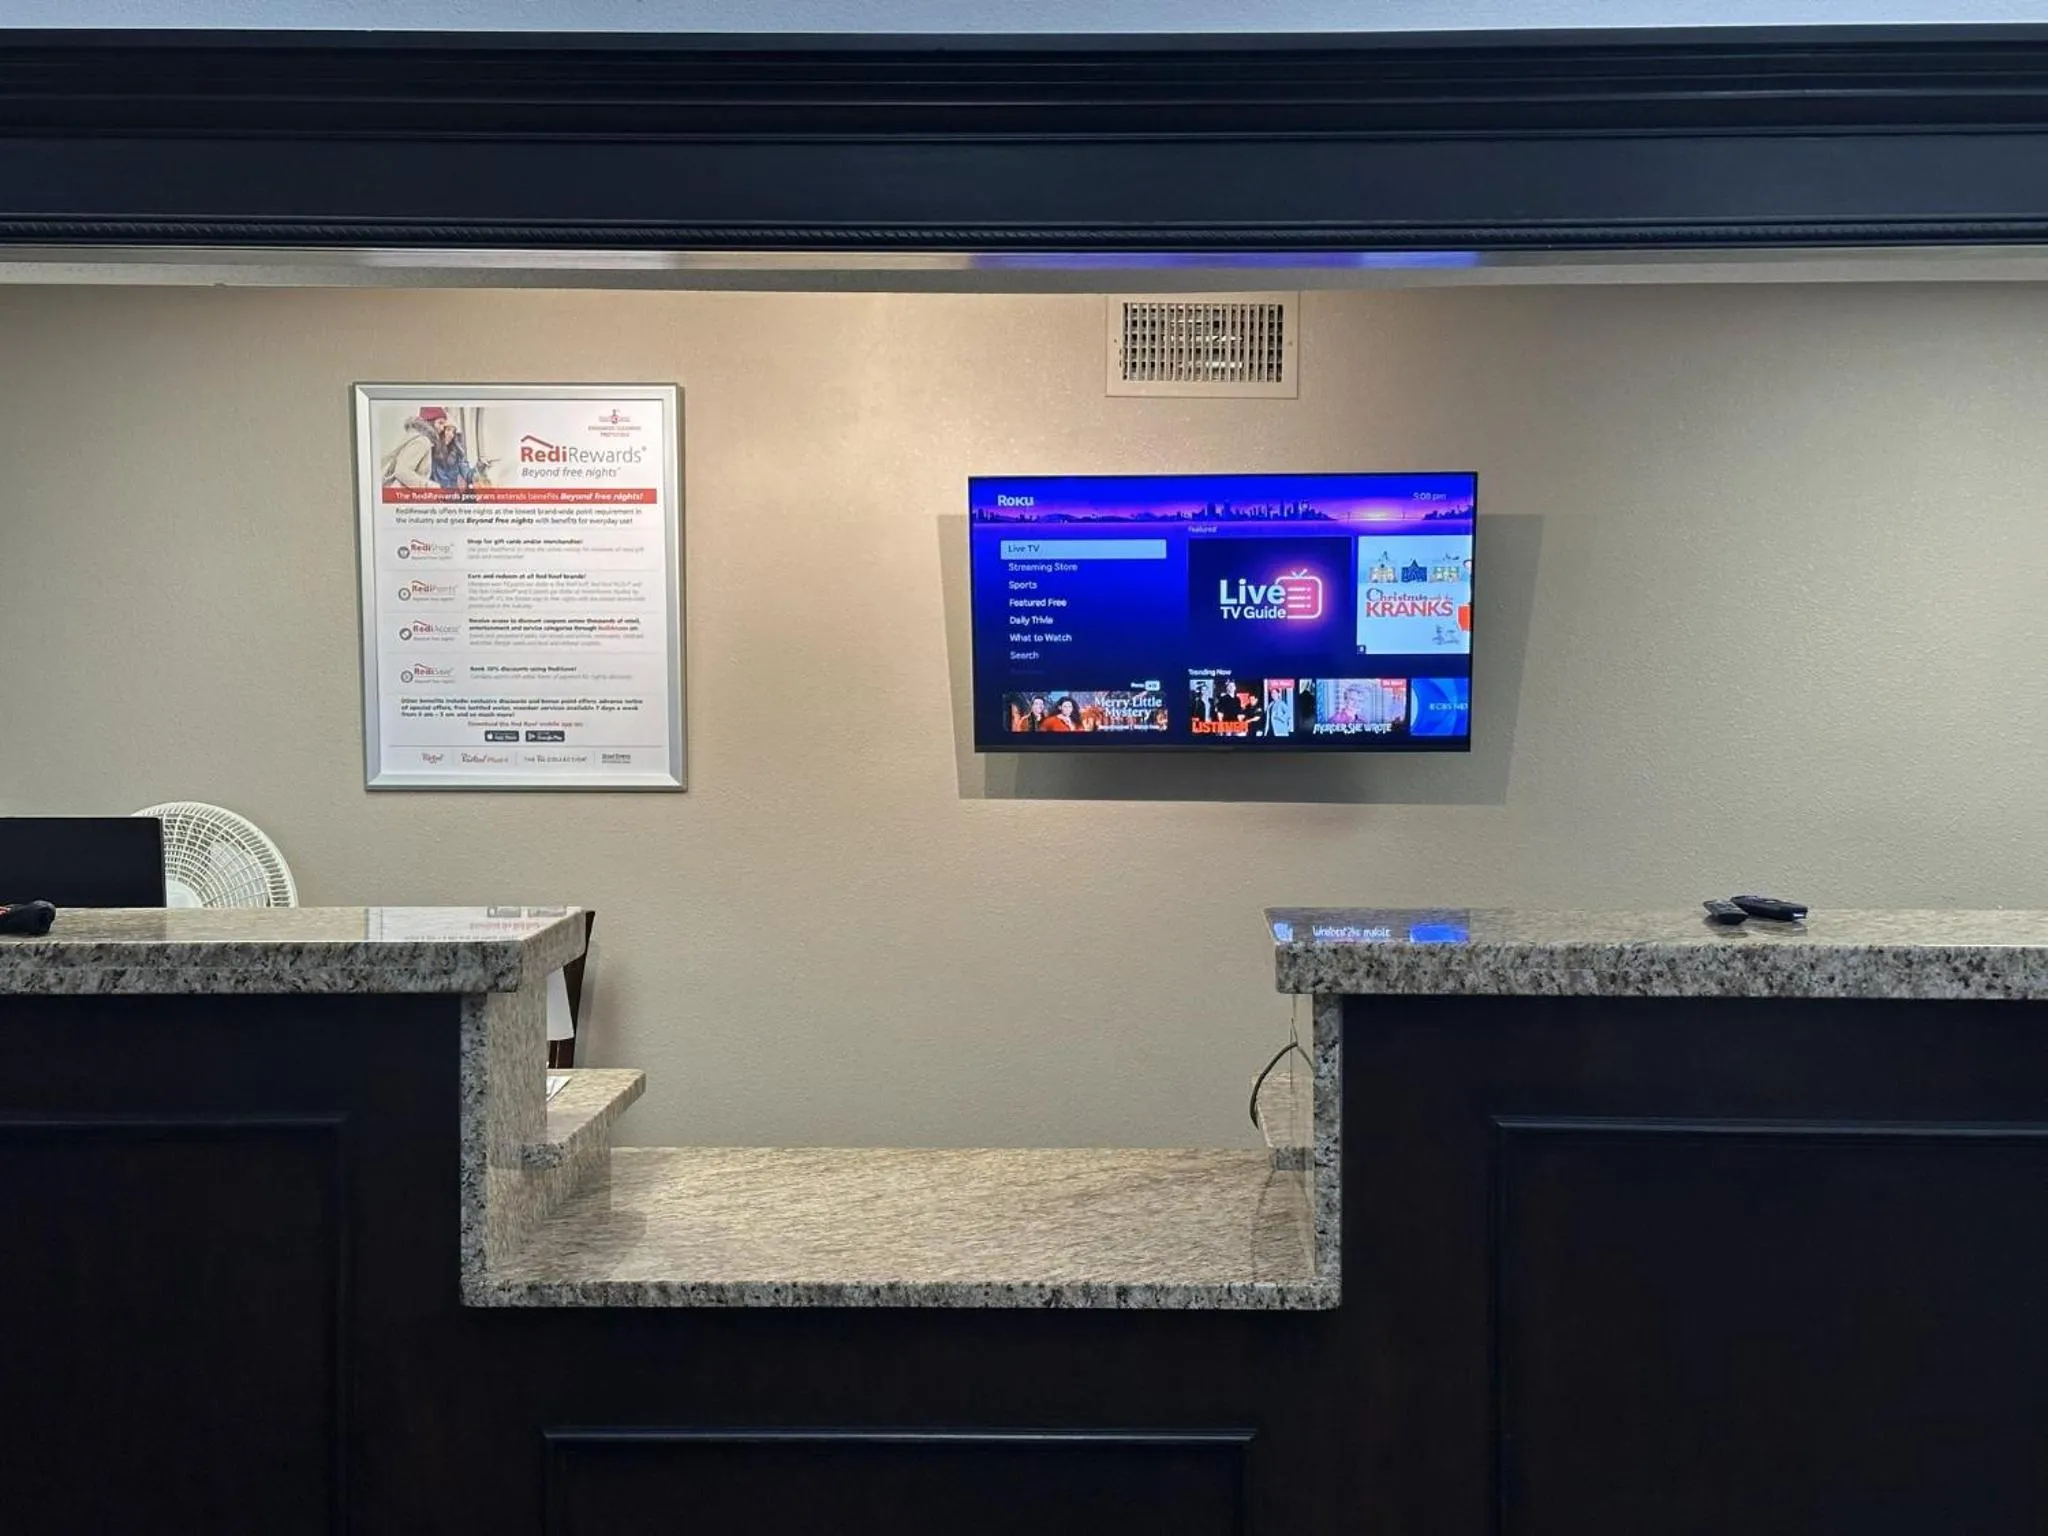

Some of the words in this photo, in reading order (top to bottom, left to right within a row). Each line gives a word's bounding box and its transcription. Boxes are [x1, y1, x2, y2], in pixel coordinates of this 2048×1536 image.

[522, 467, 559, 478] Beyond
[562, 467, 583, 476] free
[586, 467, 617, 478] nights
[396, 492, 409, 500] The
[462, 492, 495, 502] program
[497, 492, 526, 500] extends
[529, 492, 559, 500] benefits
[560, 492, 592, 502] Beyond
[595, 492, 611, 500] free
[614, 492, 643, 502] nights!
[1008, 545, 1026, 553] Live
[1027, 545, 1040, 553] TV
[1008, 563, 1052, 573] Streaming
[1054, 563, 1078, 571] Store
[1008, 581, 1037, 590] Sports
[1219, 578, 1286, 605] Live
[1009, 598, 1046, 607] Featured
[1048, 598, 1067, 607] Free
[1219, 606, 1242, 619] TV
[1243, 606, 1287, 619] Guide
[1366, 601, 1454, 617] KRANKS
[1009, 616, 1030, 626] Daily
[1031, 616, 1053, 624] Trivia
[1009, 633, 1032, 642] What
[1034, 633, 1043, 642] to
[1045, 633, 1072, 642] Watch
[1010, 651, 1039, 660] Search
[1095, 696, 1130, 709] Merry
[1131, 696, 1162, 708] Little
[1105, 707, 1151, 720] Mystery
[1364, 724, 1392, 735] WROTE
